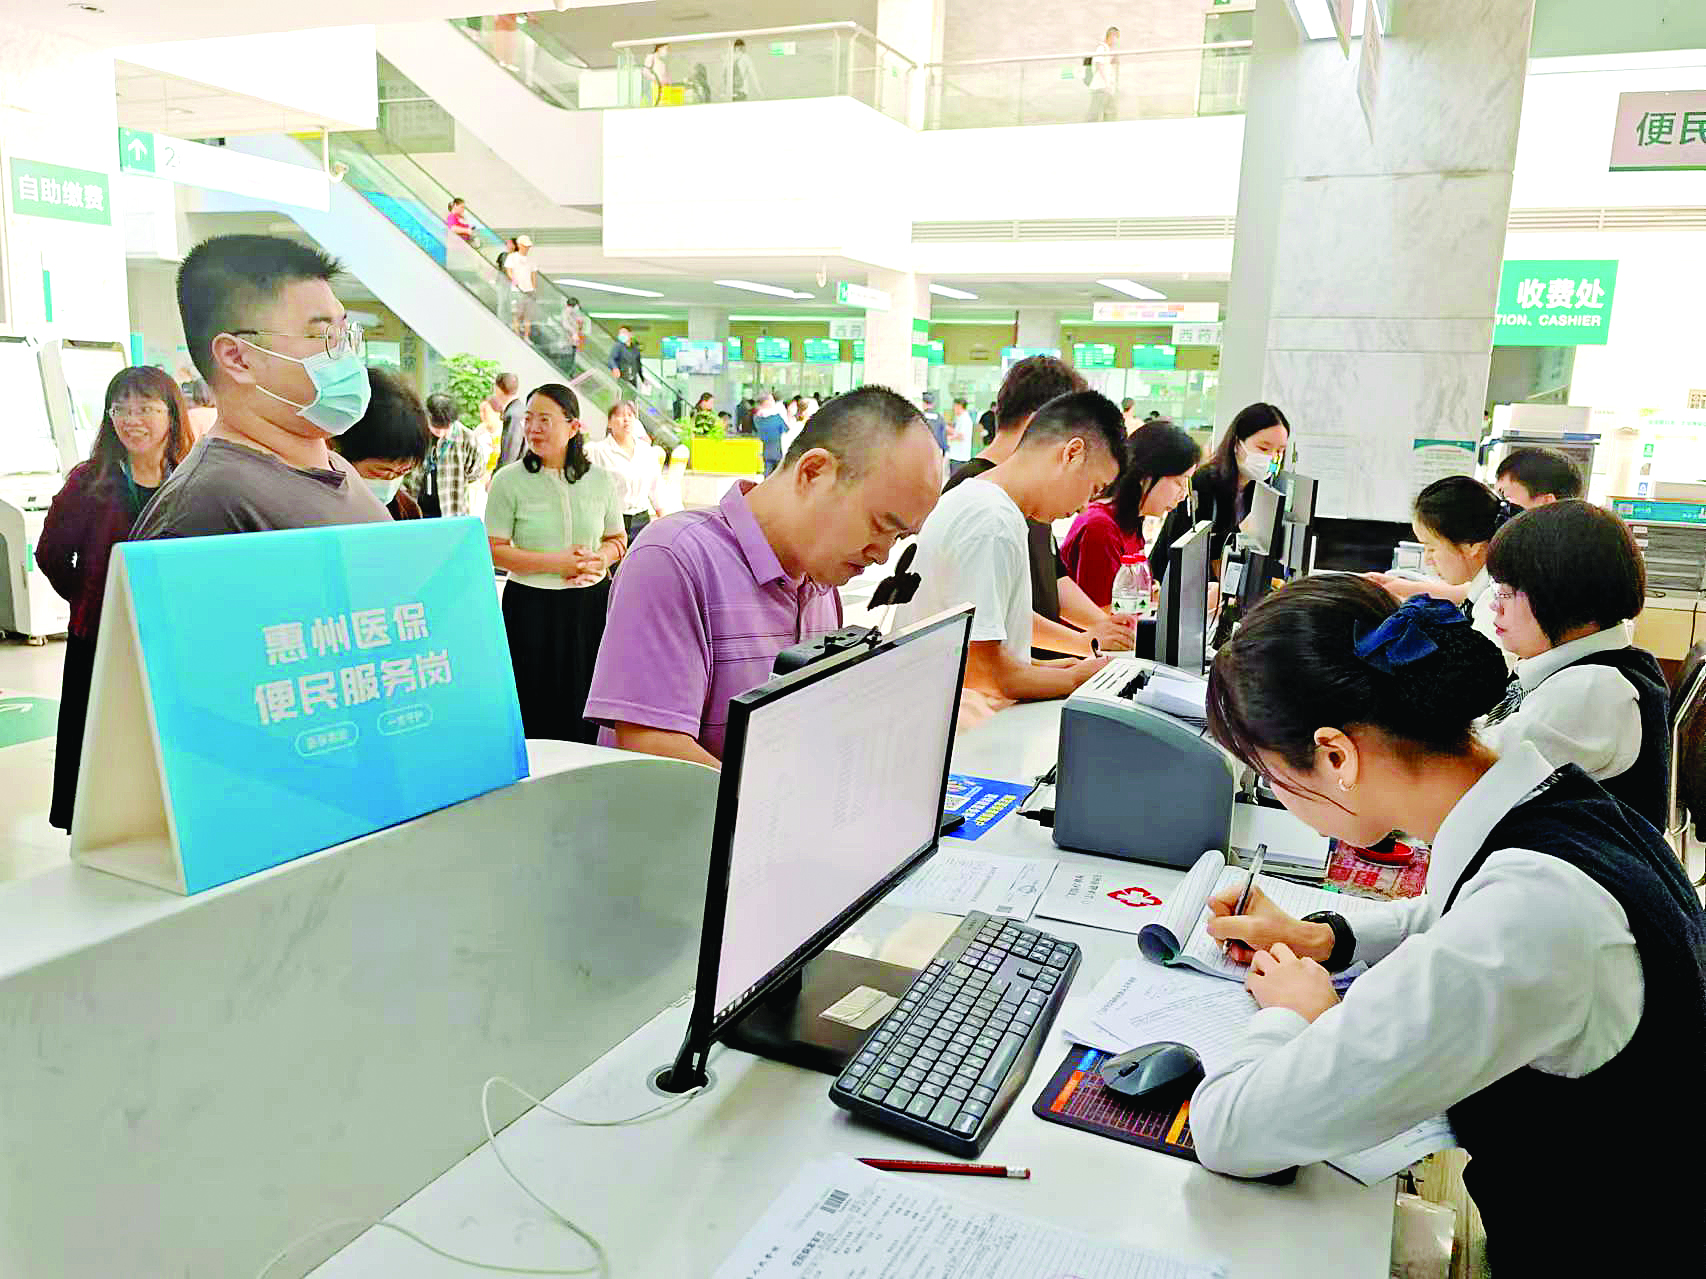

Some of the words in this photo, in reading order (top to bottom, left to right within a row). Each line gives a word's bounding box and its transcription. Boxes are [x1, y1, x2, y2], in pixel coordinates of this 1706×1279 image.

[18, 174, 104, 212] 自助缴费
[1517, 278, 1605, 309] 收费处
[1539, 315, 1602, 327] CASHIER
[262, 601, 431, 666] 惠州医保
[255, 648, 452, 726] 便民服务岗
